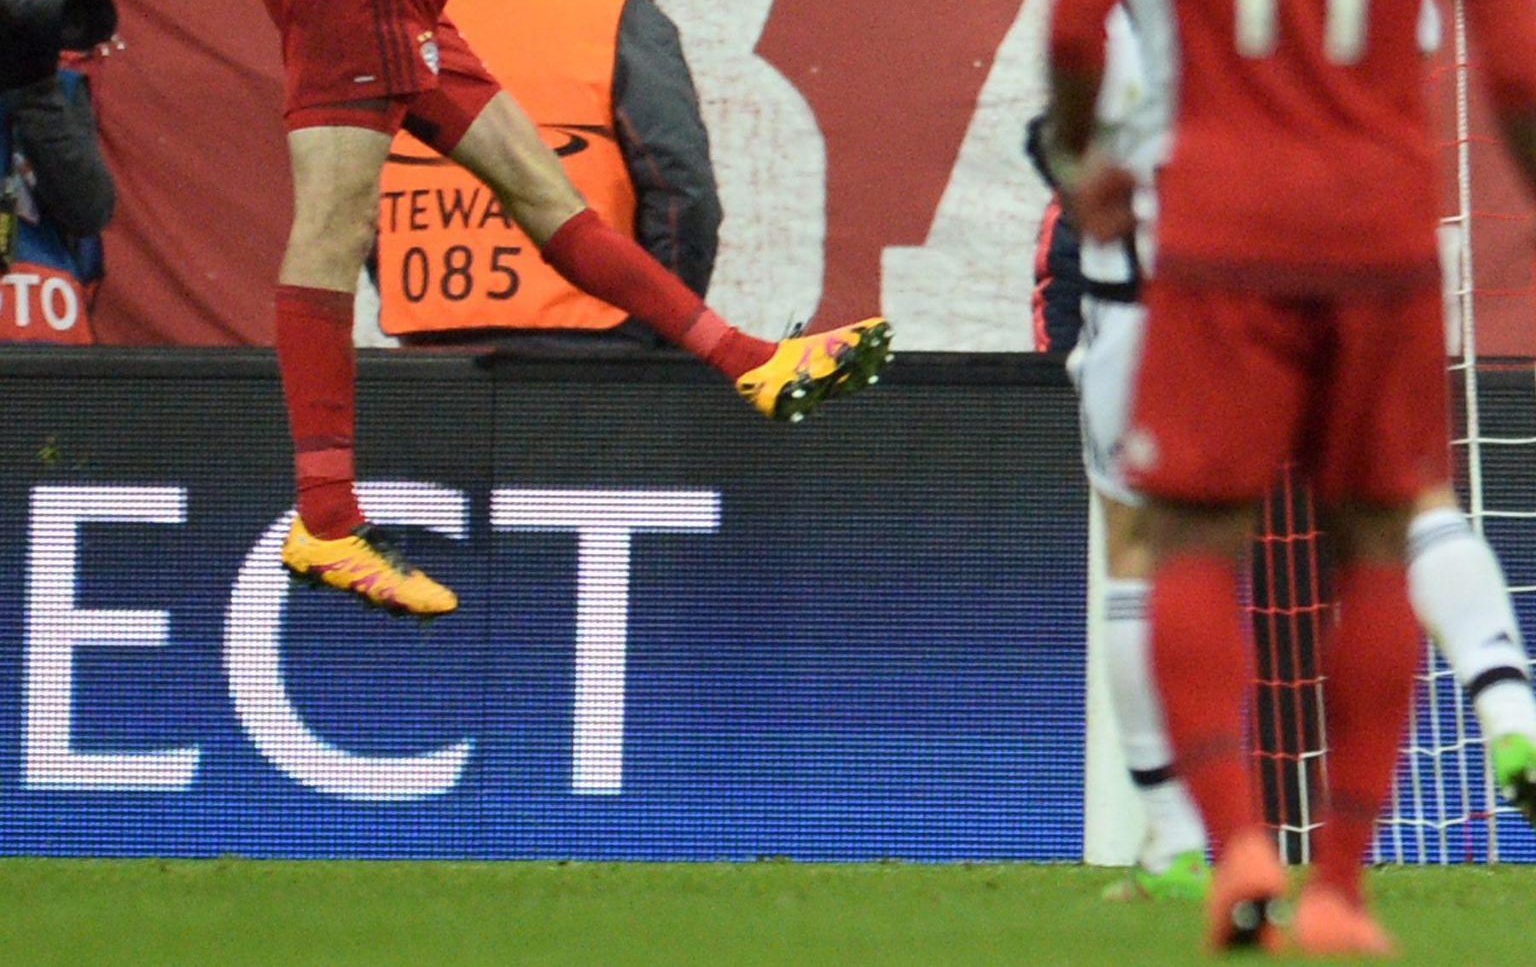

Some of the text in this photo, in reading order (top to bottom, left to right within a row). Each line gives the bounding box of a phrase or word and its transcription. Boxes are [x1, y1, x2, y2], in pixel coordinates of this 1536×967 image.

[383, 188, 514, 234] TEWA
[0, 274, 78, 330] TO
[402, 246, 522, 302] 085
[20, 480, 724, 800] ECT
